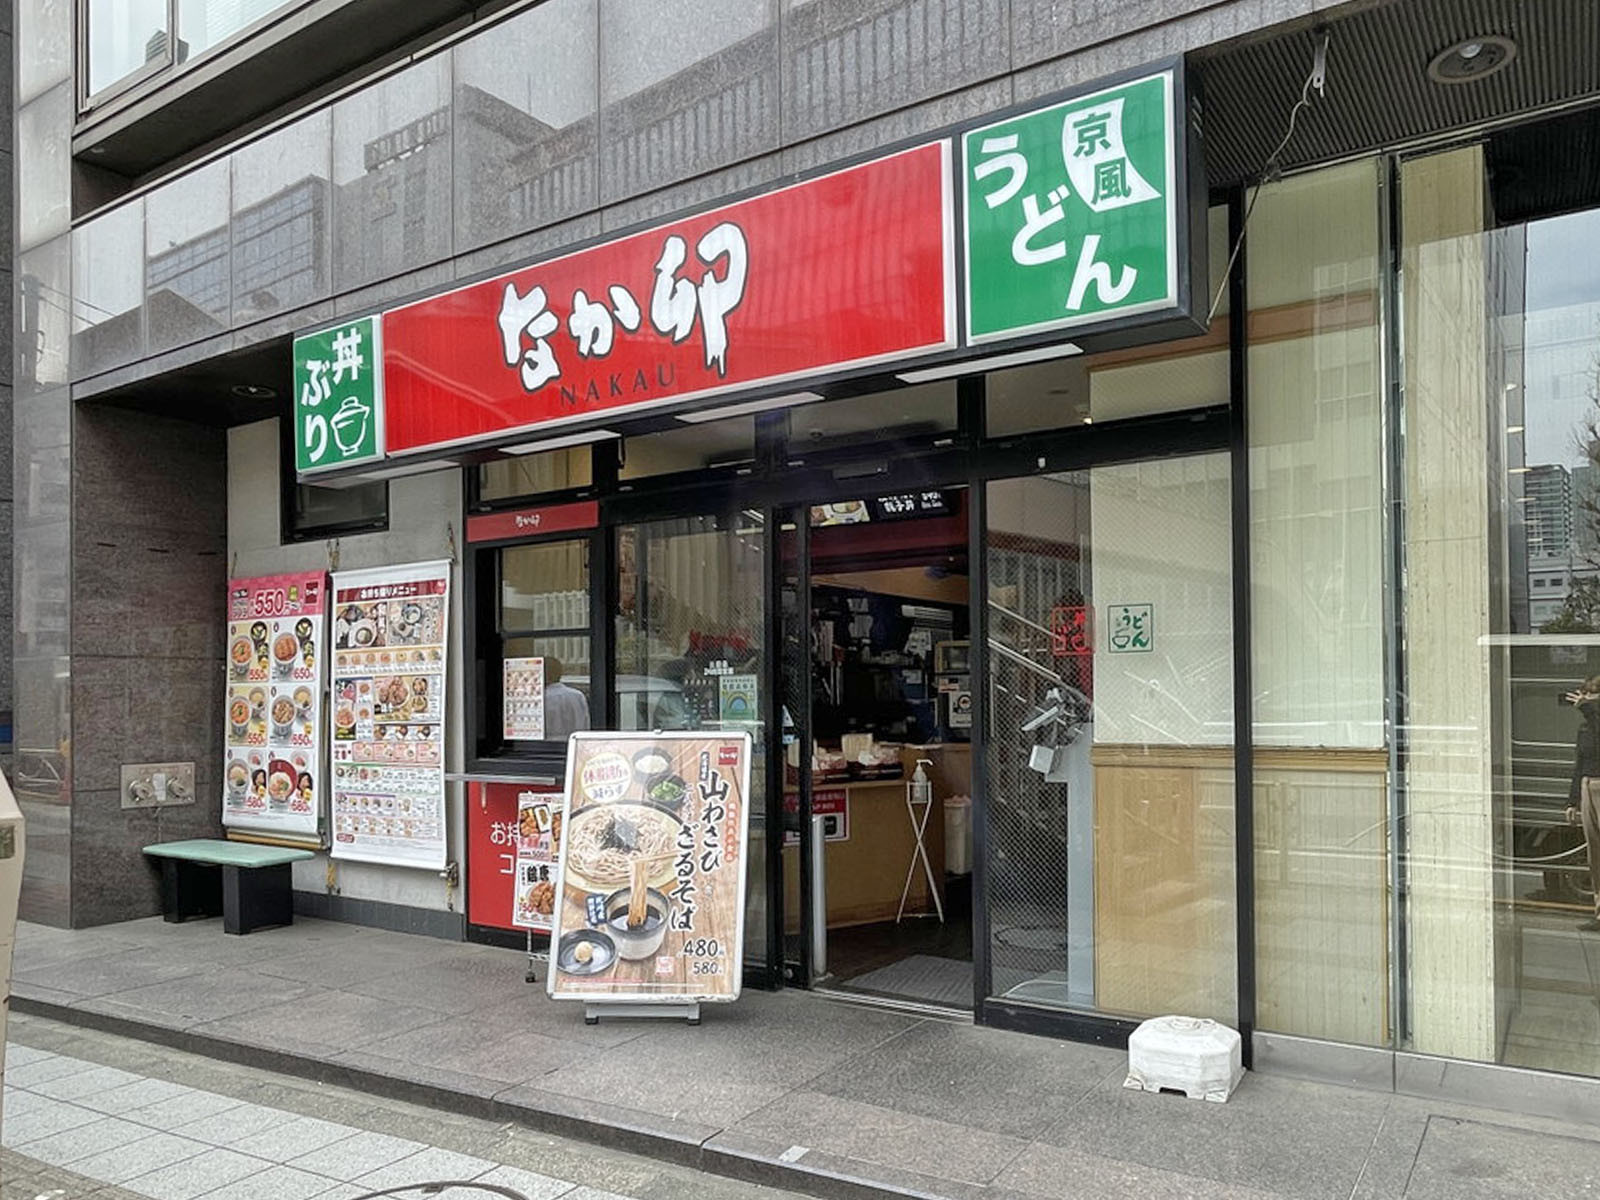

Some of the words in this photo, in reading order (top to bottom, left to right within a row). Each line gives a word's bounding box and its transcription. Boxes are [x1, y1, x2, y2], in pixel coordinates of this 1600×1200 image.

[1073, 112, 1131, 204] 京風
[974, 134, 1137, 310] うどん
[498, 222, 748, 393] なか卯
[560, 364, 676, 407] NAKAU
[255, 590, 283, 615] 550
[1121, 607, 1150, 648] うどん
[671, 823, 701, 931] ざるそば
[684, 939, 719, 957] 480
[693, 961, 719, 975] 580
